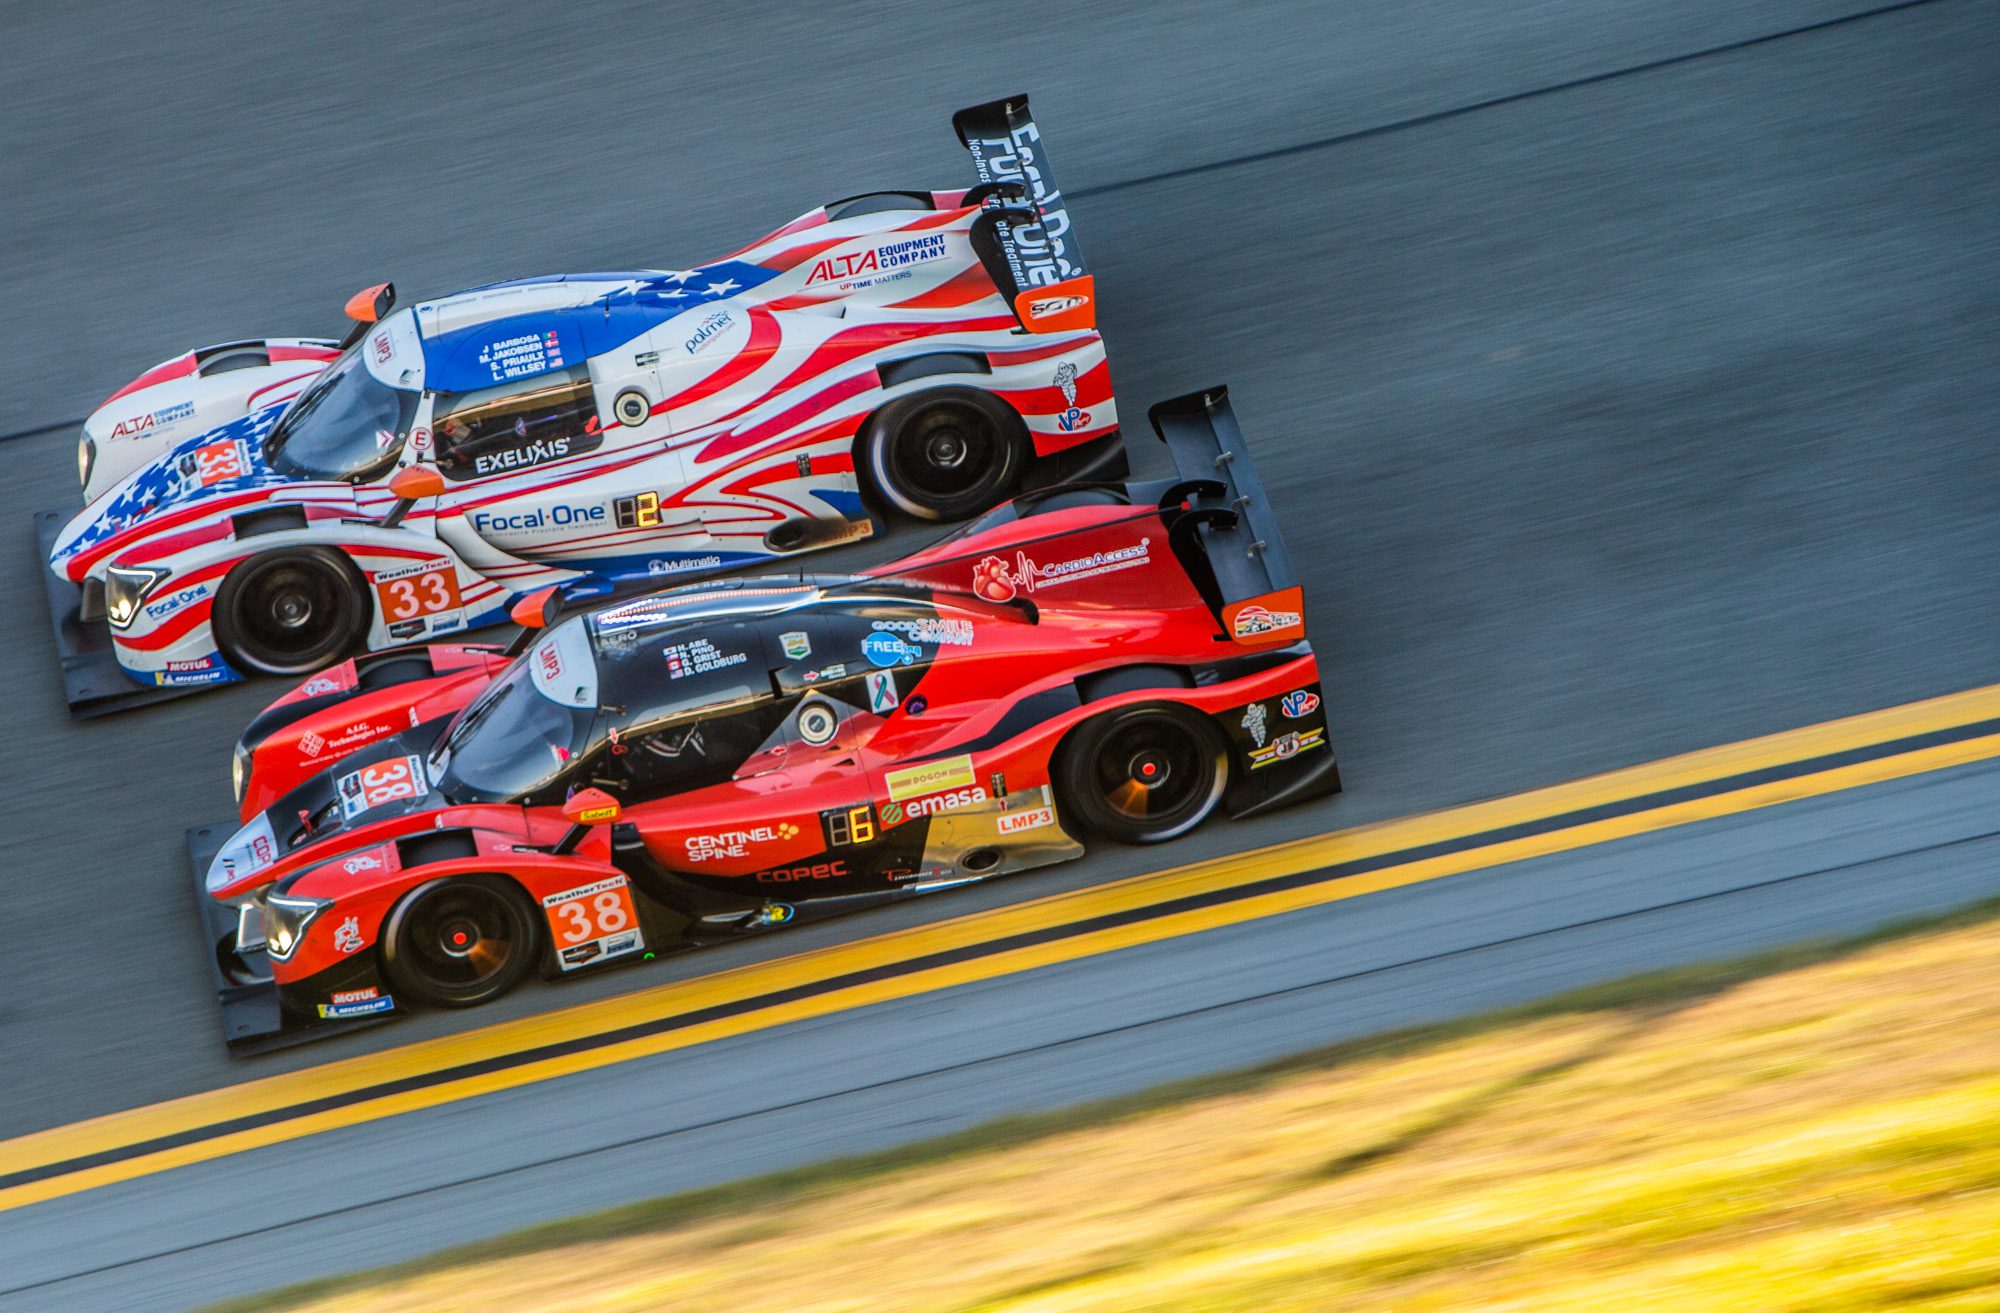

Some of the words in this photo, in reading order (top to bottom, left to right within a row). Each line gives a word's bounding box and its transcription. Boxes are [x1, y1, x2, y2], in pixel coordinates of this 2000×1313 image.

[878, 233, 945, 258] EQUIPMENT
[804, 249, 879, 286] ALTA
[880, 245, 946, 269] COMPANY
[1003, 233, 1030, 288] Treatment
[874, 270, 912, 285] MATTERS
[493, 333, 541, 351] BARBOSA
[685, 313, 732, 354] palmer
[374, 330, 392, 364] LMP3
[479, 354, 492, 364] M.
[492, 341, 543, 361] JAKOBSEN
[490, 361, 502, 372] S.
[502, 350, 545, 369] PRIAULX
[492, 371, 505, 382] L.
[504, 360, 547, 378] WILLSEY
[110, 413, 154, 440] ALTA
[1058, 408, 1081, 432] VP
[415, 431, 426, 446] E
[198, 447, 241, 480] 33
[637, 492, 658, 527] 2
[664, 555, 721, 572] Multimatic
[389, 572, 450, 619] 33
[688, 639, 708, 650] ABE
[691, 645, 714, 656] PINO
[169, 659, 210, 672] MOTUL
[540, 642, 560, 680] LMP3
[682, 659, 692, 667] G.
[693, 651, 721, 664] GRIST
[684, 667, 695, 676] D.
[695, 653, 747, 673] GOLDBURG
[1283, 692, 1306, 717] VP
[364, 764, 412, 802] 38
[906, 787, 986, 818] emasa
[850, 806, 874, 843] 6
[1000, 811, 1051, 832] LMP3
[685, 827, 777, 850] CENTINEL
[546, 877, 624, 905] WeatherTech
[558, 891, 627, 943] 38
[334, 989, 376, 1004] MOTUL
